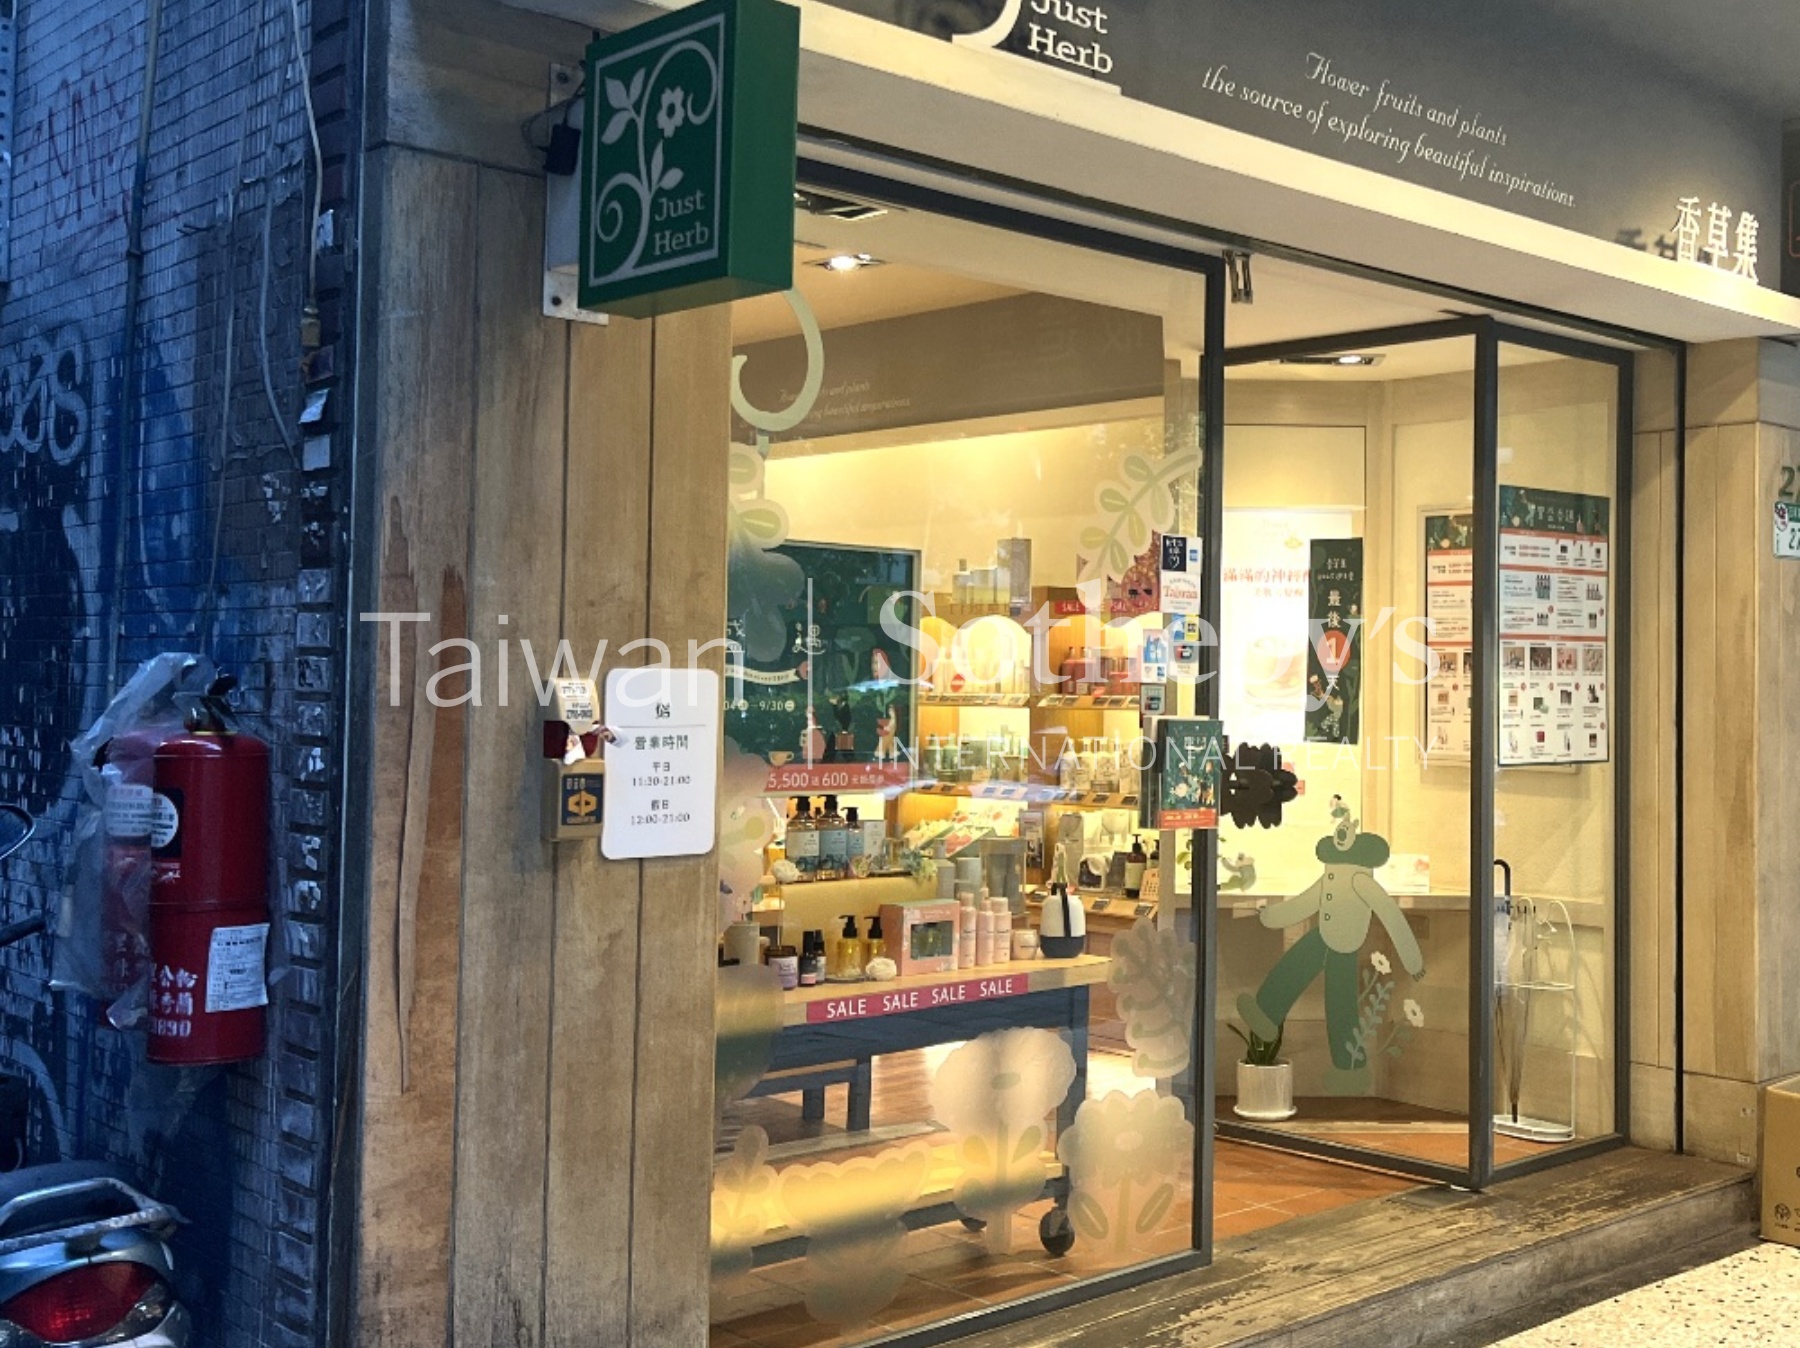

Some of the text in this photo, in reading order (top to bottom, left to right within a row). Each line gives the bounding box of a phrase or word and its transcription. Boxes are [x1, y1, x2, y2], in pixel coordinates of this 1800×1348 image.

[1027, 22, 1114, 74] Herb
[1305, 52, 1508, 146] Flower fruits and plants
[1240, 86, 1303, 119] source
[1306, 100, 1329, 135] of
[1328, 114, 1411, 164] exploring
[1414, 133, 1490, 181] beautiful
[654, 189, 706, 222] Just
[653, 223, 709, 256] Herb
[1670, 196, 1760, 282] 香草集
[635, 734, 689, 751] 營業時間
[652, 761, 671, 773] 平日
[768, 772, 809, 790] 5,500
[822, 772, 849, 787] 600
[827, 978, 1013, 1019] SALE SALE SALE SALE
